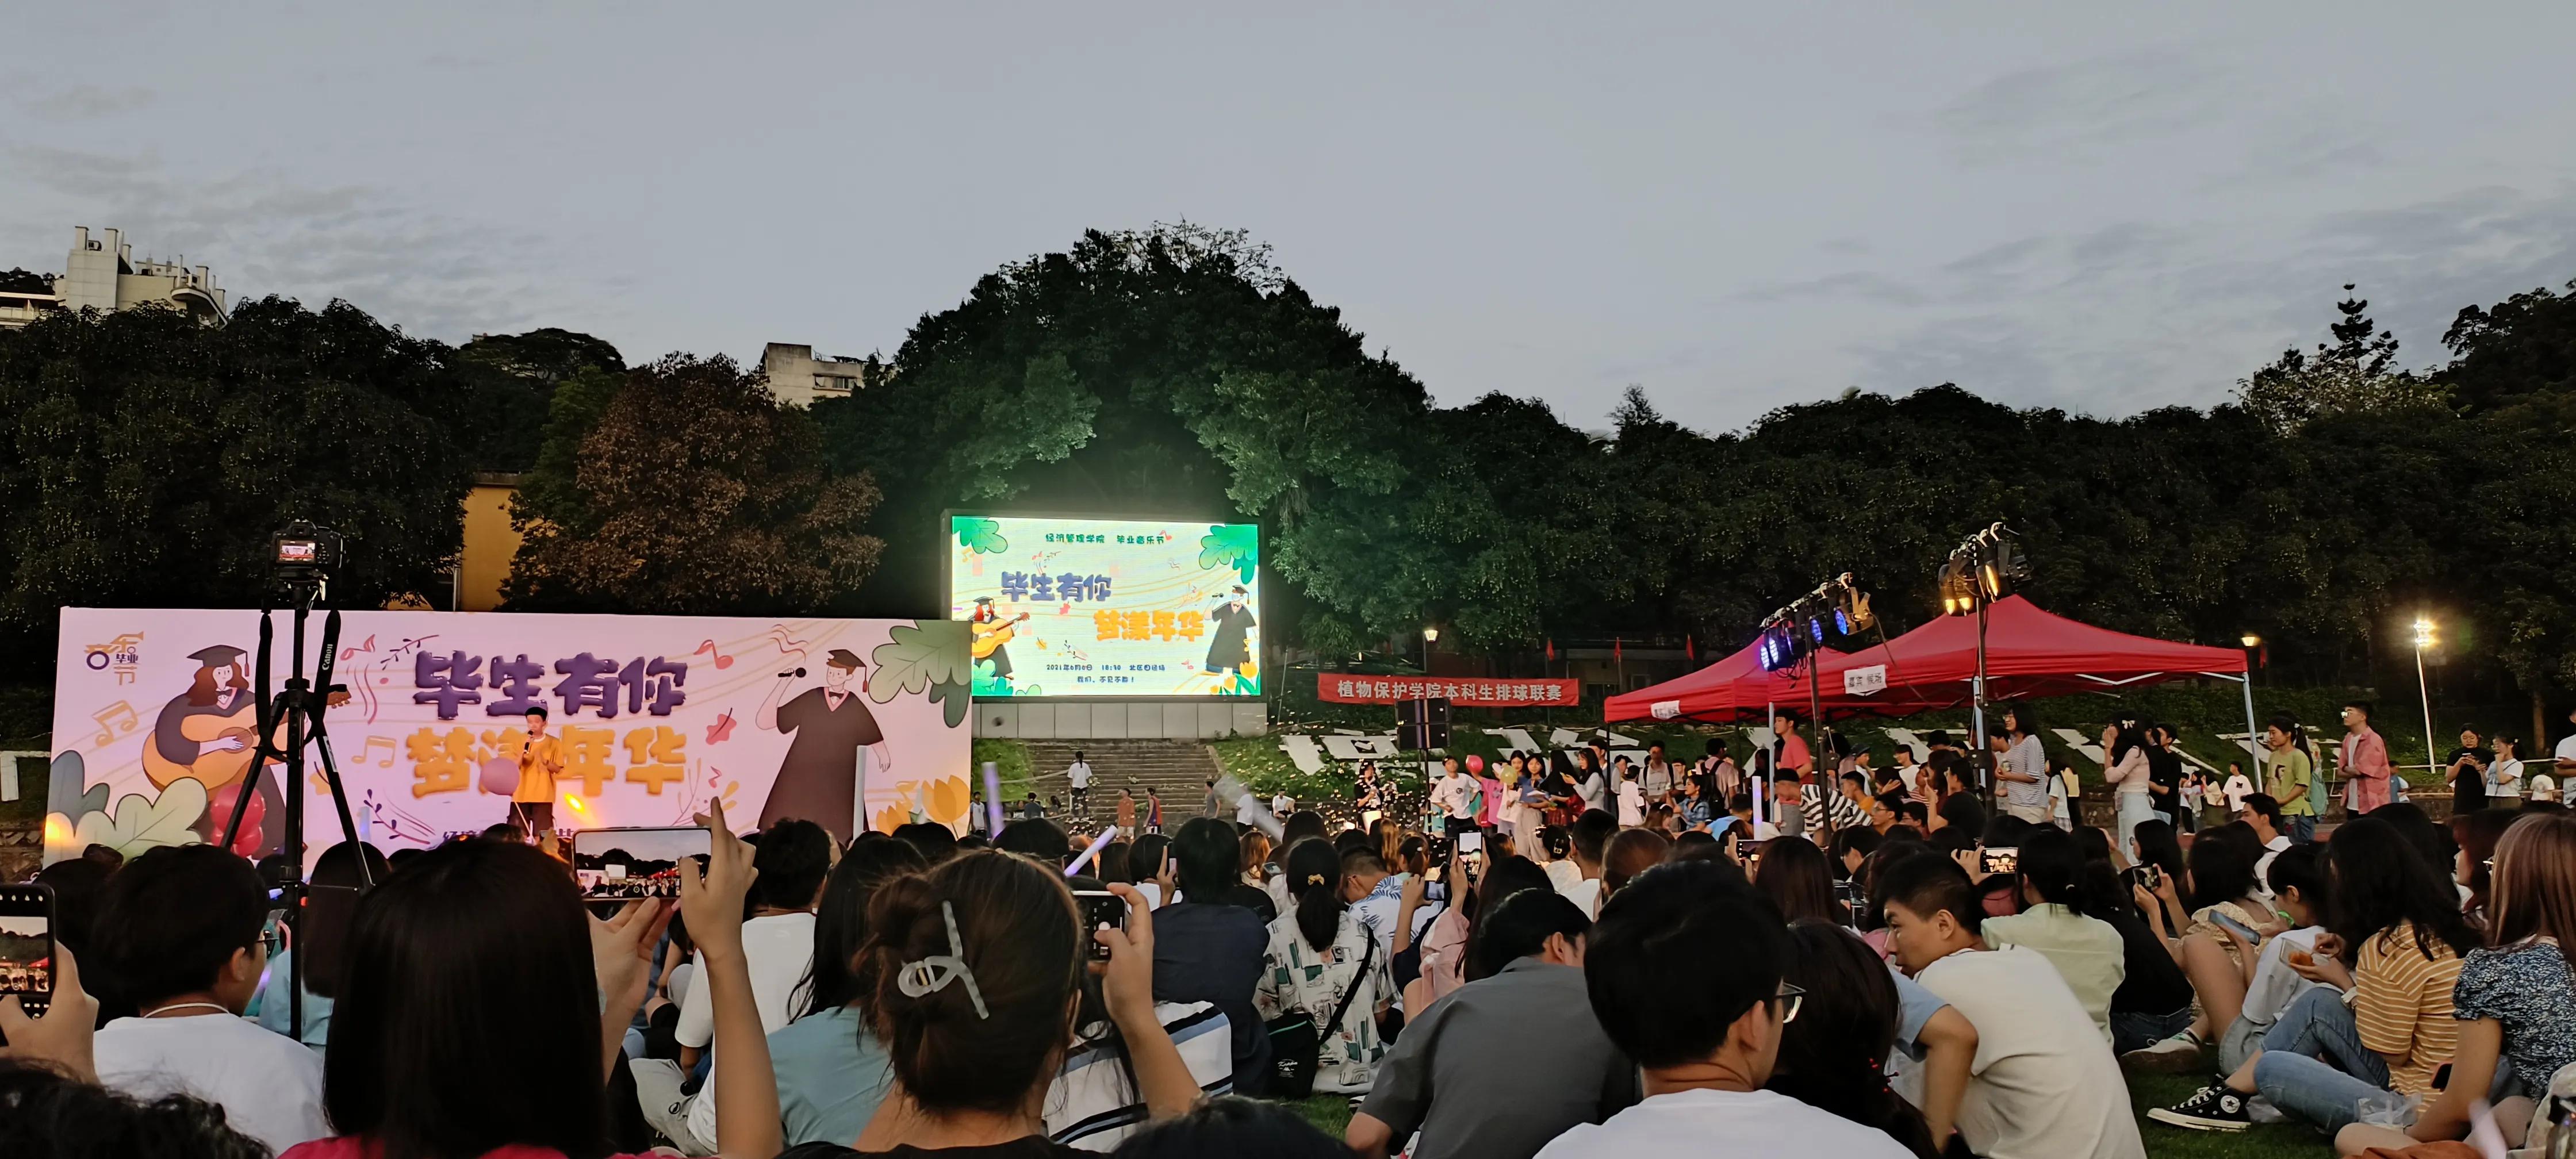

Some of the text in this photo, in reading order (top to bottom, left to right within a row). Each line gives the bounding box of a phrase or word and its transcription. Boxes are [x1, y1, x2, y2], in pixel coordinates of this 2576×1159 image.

[1045, 533, 1164, 544] 经济管理学院 毕业音乐节
[1001, 571, 1112, 602] 毕生有你
[1094, 610, 1204, 642] 梦漾年华
[322, 644, 333, 670] Canon
[412, 650, 688, 720] 毕生有你
[1337, 680, 1561, 701] 植物保护学院本科生排球联赛
